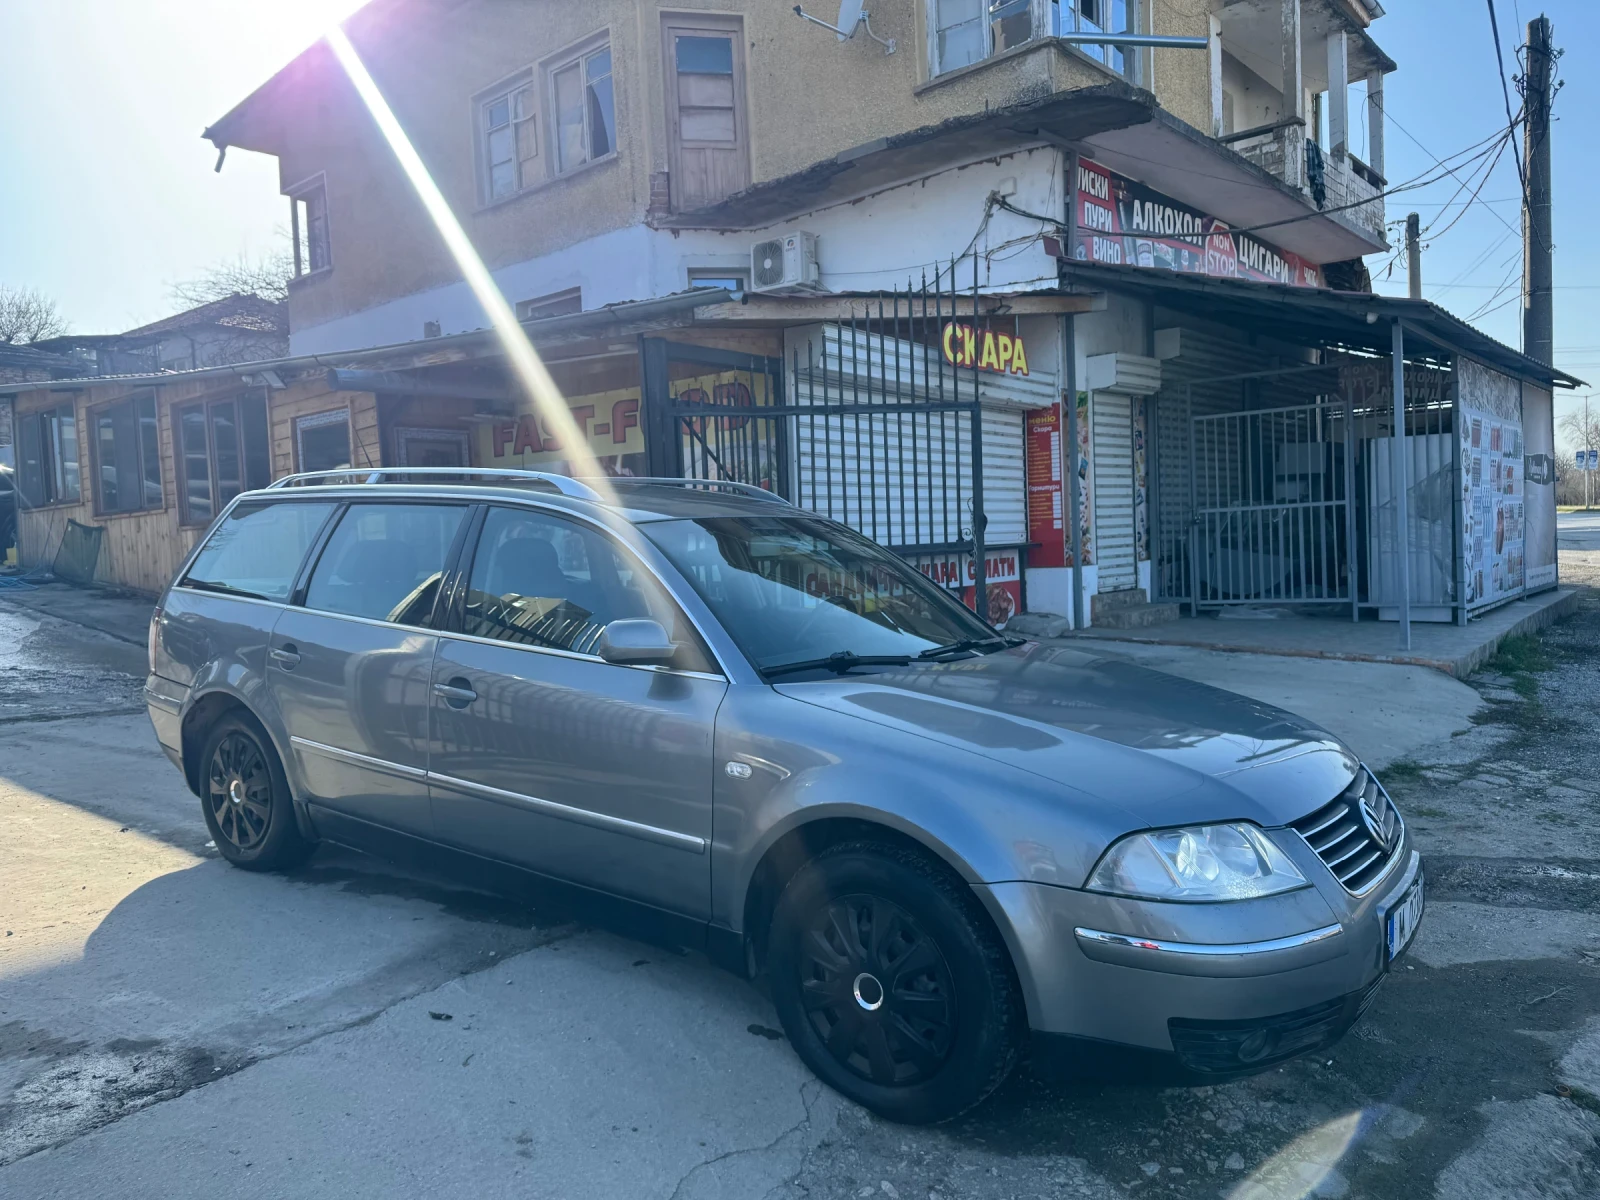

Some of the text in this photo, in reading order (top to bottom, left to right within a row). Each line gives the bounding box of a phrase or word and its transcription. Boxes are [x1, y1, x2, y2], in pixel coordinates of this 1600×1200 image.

[1084, 201, 1113, 233] ПУРИ
[1132, 199, 1203, 246] АЛКОХОЛ
[1092, 236, 1121, 264] ВИНО
[1212, 233, 1230, 251] NON
[1208, 249, 1235, 276] STOP
[1239, 235, 1289, 283] ЦИГАРИ
[943, 322, 1029, 375] СКАРА
[492, 383, 751, 458] FAST-FOD
[915, 562, 959, 583] КАРА
[967, 557, 1016, 581] СЛАТИ
